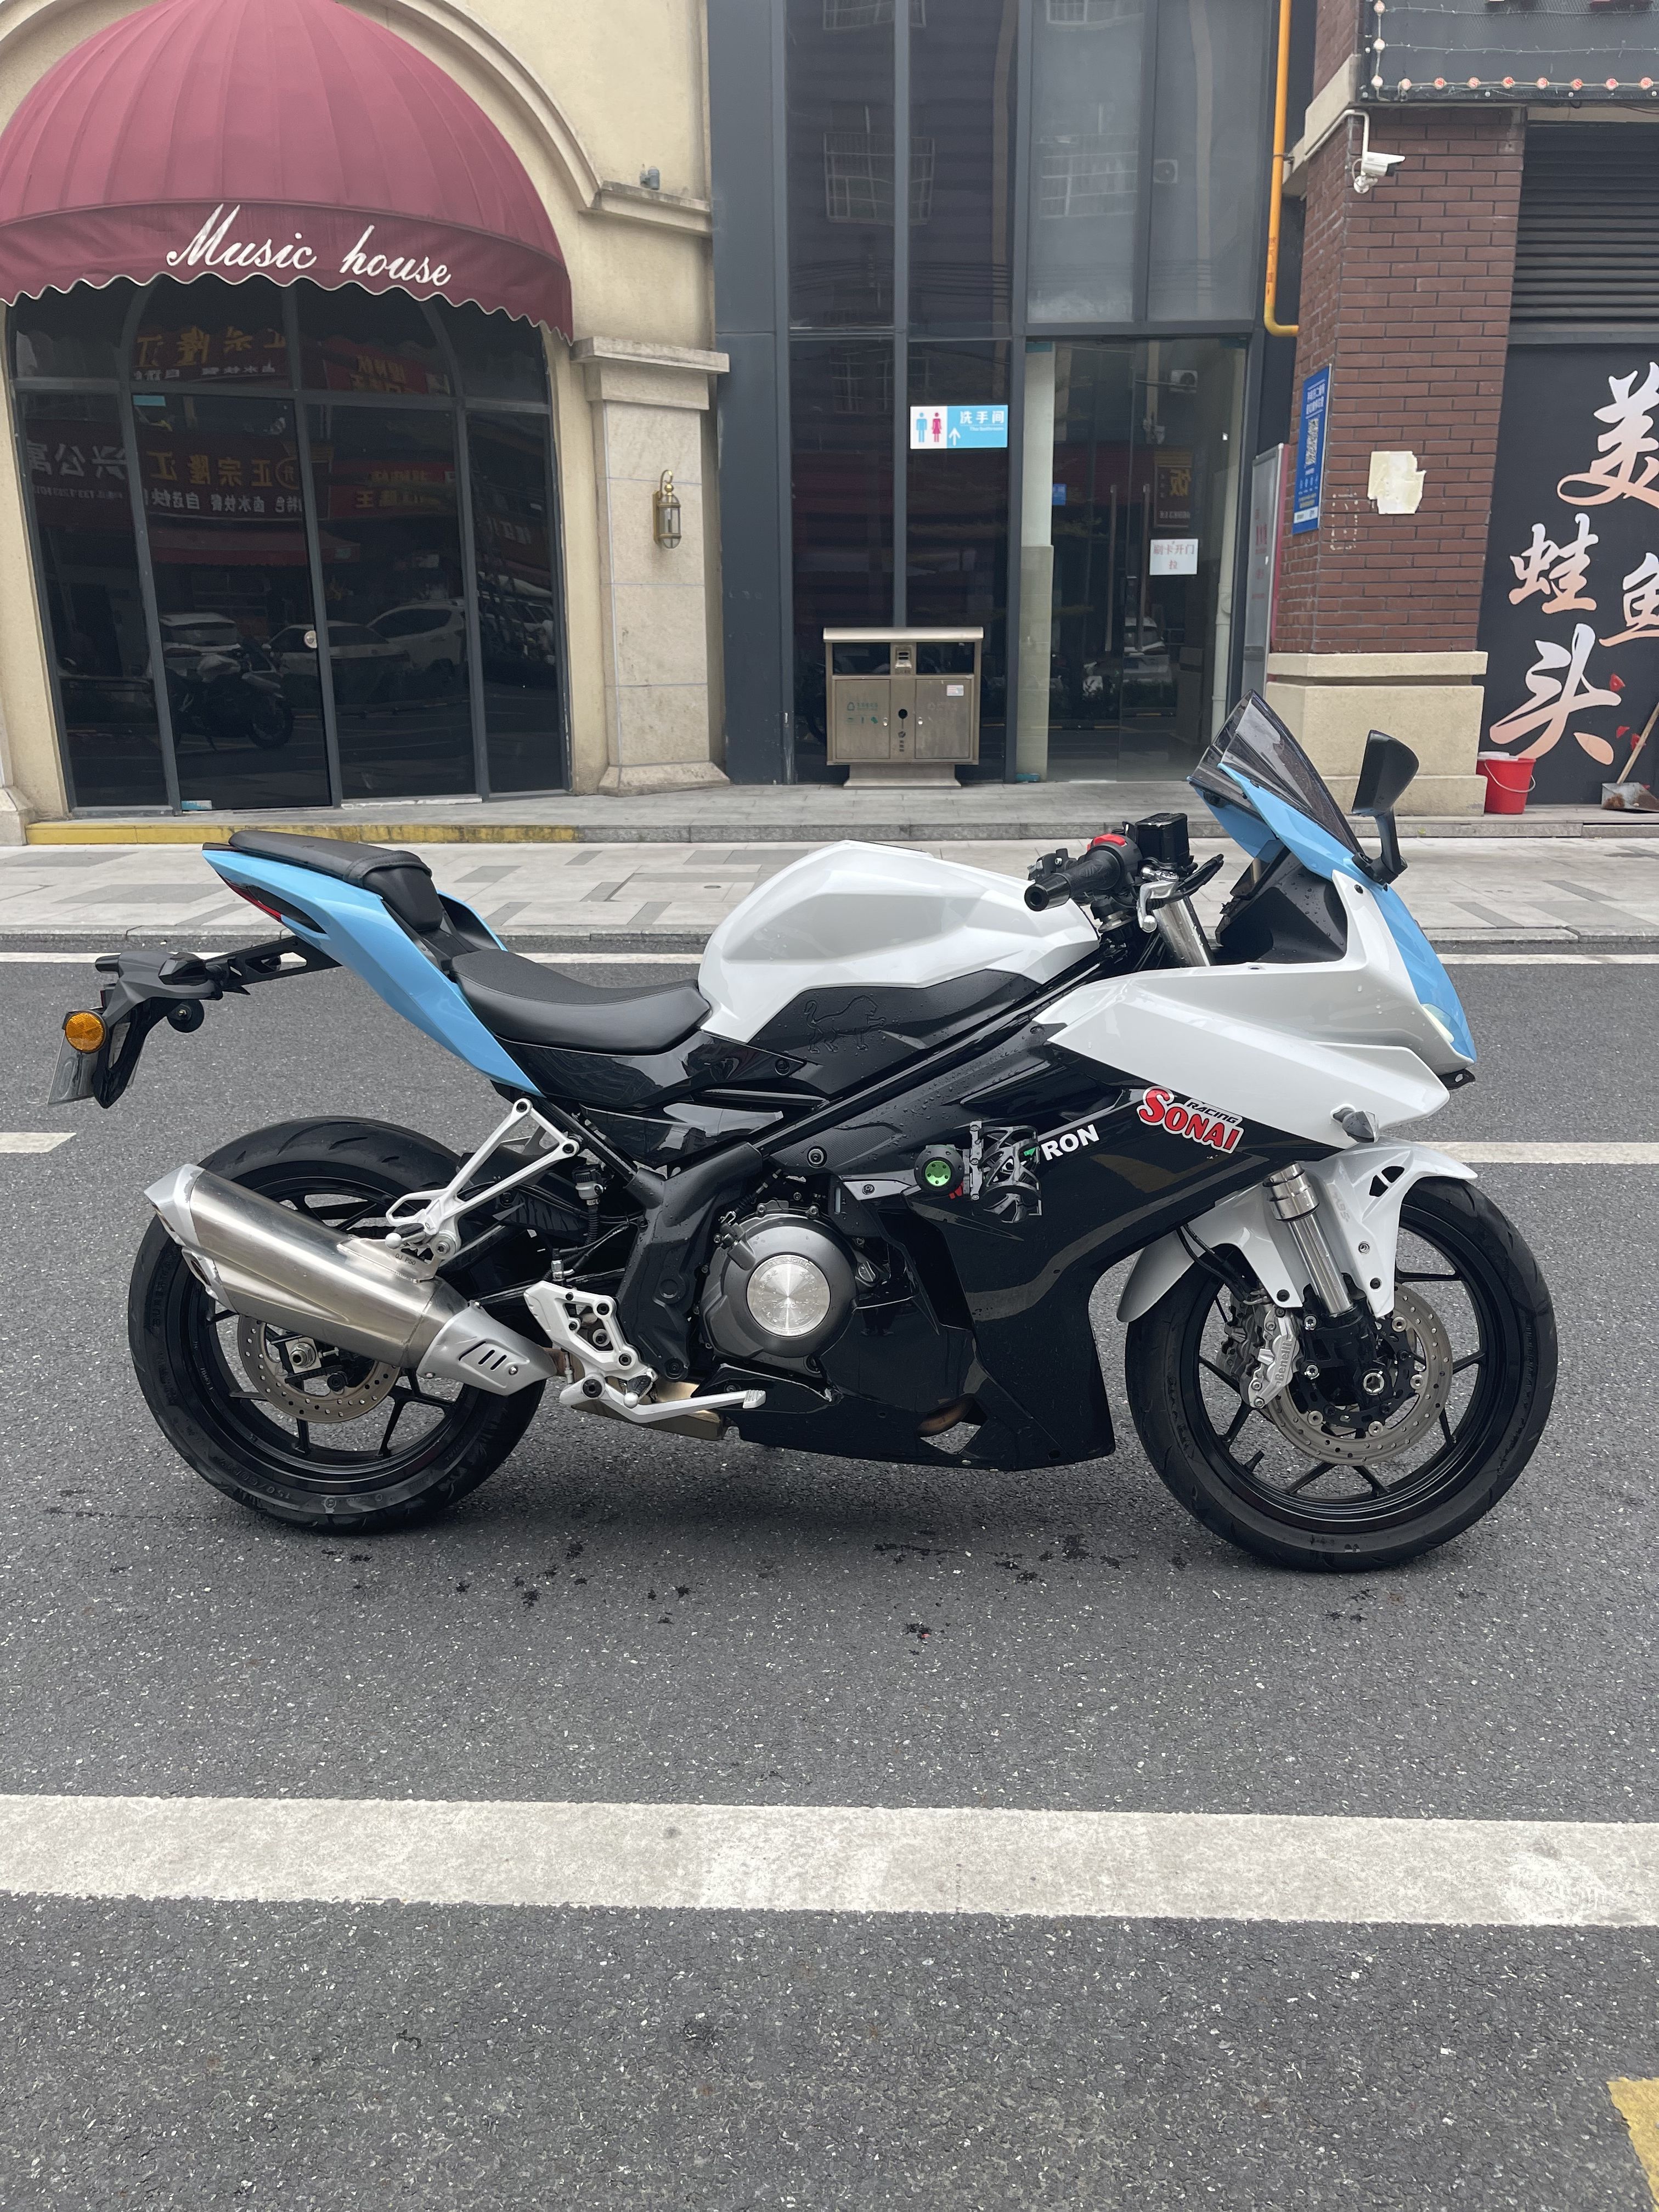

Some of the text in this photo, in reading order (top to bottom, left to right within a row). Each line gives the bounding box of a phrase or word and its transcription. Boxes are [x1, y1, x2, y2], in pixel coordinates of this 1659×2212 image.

[166, 204, 451, 286] Music house
[960, 410, 1005, 424] 洗手间
[1556, 362, 1659, 509] 美
[1510, 512, 1598, 614] 蛙
[1489, 623, 1621, 765] 头
[1138, 1088, 1240, 1151] SONAI
[1186, 1100, 1239, 1124] RACING
[1274, 1341, 1293, 1381] Benelli
